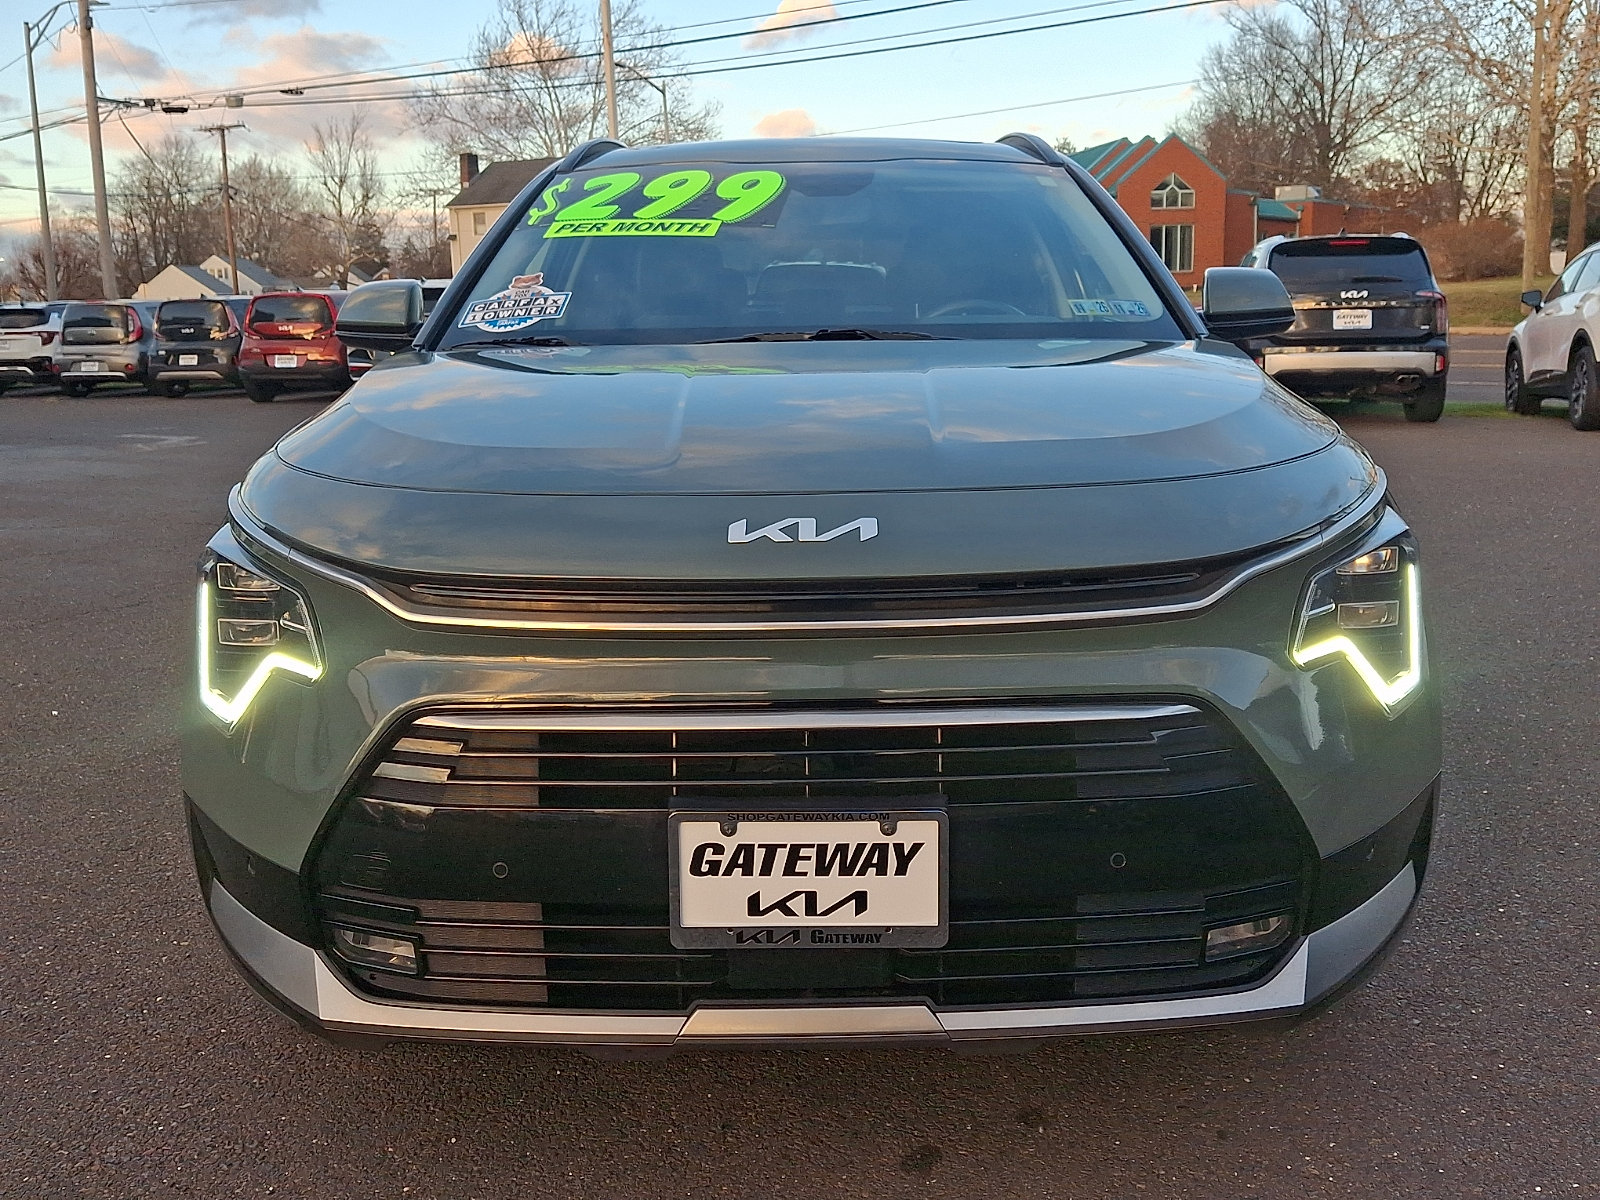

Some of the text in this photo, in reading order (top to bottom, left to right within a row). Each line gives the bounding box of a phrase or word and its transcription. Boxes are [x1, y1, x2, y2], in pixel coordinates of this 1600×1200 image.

[527, 170, 787, 225] $299
[554, 221, 712, 234] PER MONTH
[474, 298, 561, 312] CARFAX
[483, 306, 558, 321] OWNER
[728, 517, 878, 543] KIA
[727, 812, 890, 822] SHOPGATEWAYKIA.COM
[689, 842, 926, 877] GATEWAY
[747, 890, 868, 917] KIA
[735, 929, 801, 945] KIA
